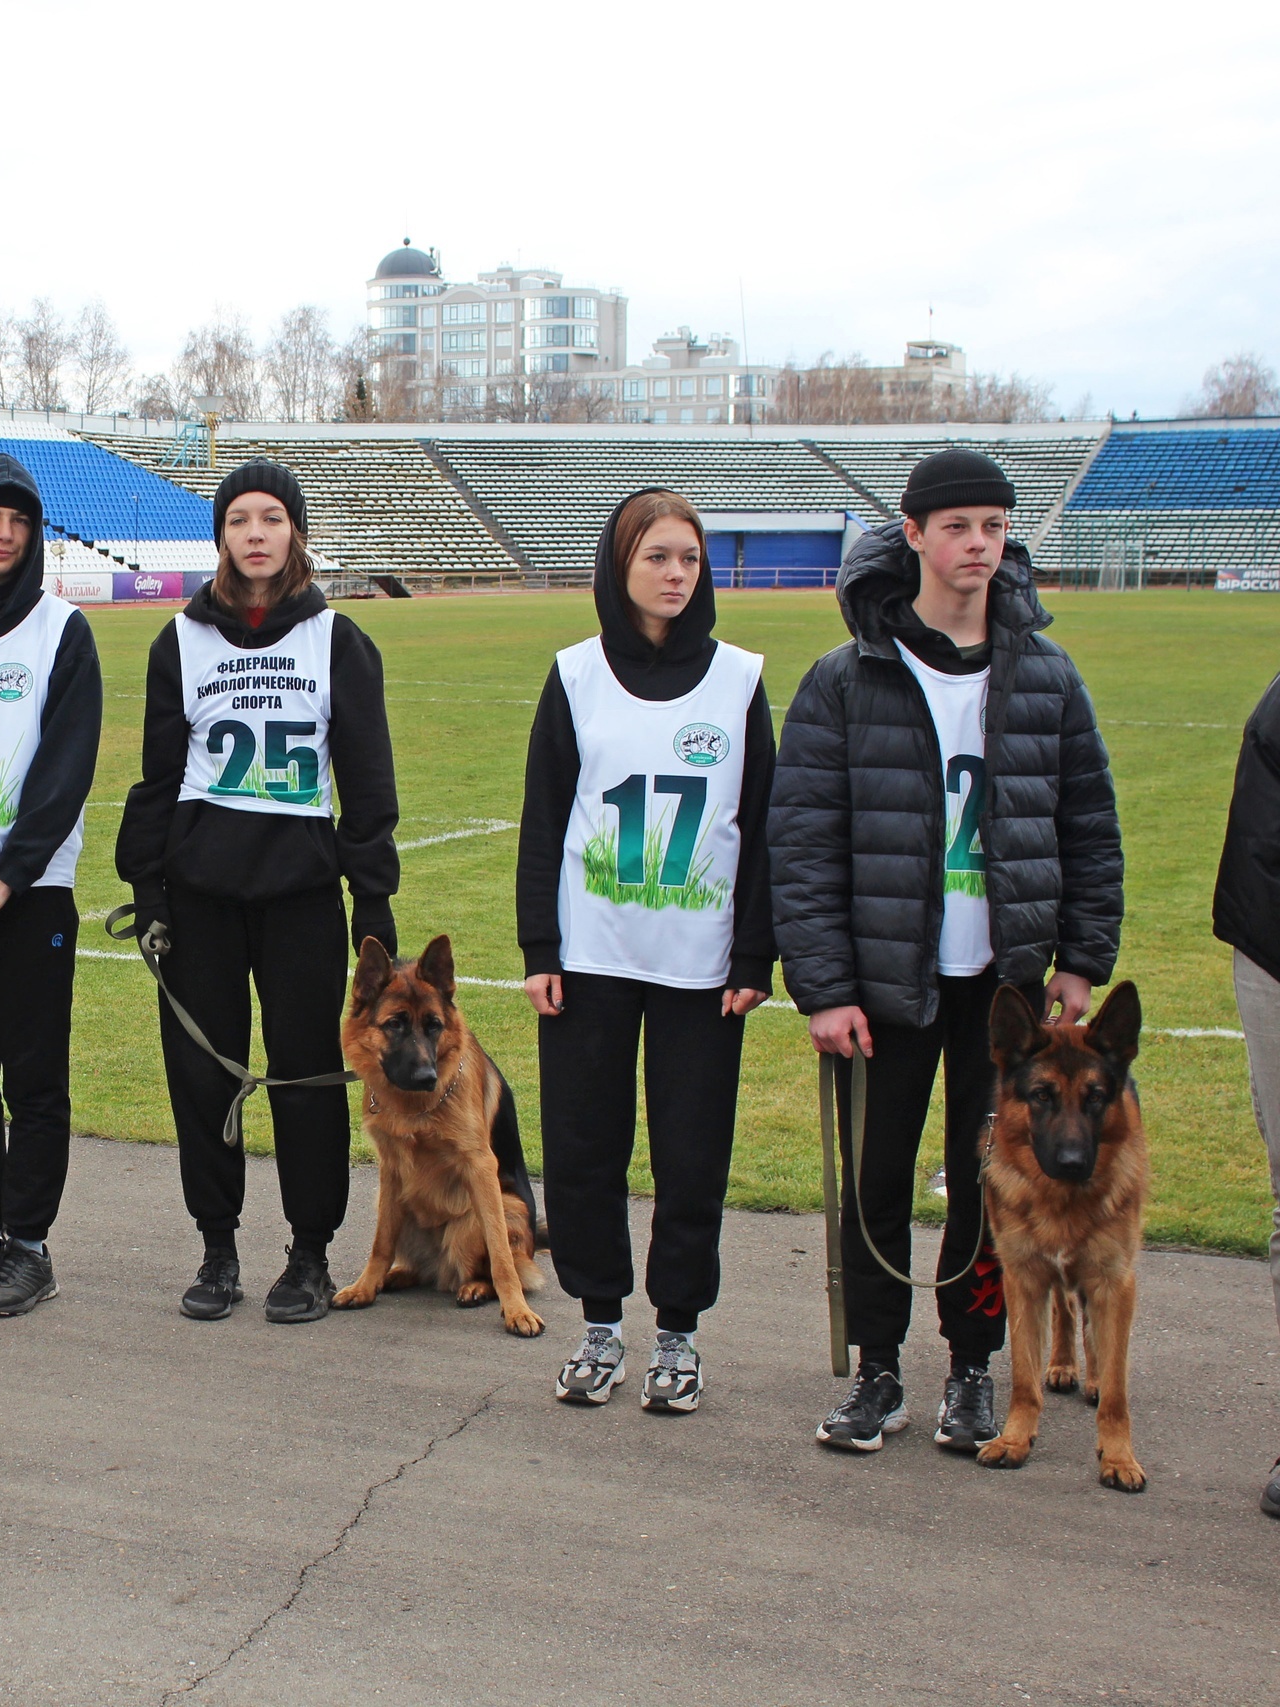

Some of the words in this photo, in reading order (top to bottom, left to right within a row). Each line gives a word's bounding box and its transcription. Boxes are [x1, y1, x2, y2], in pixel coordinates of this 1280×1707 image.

[134, 575, 163, 596] Gallery
[217, 656, 295, 675] ФЕДЕРАЦИЯ
[197, 676, 317, 700] КИНОЛОГИЧЕСКОГО
[231, 695, 283, 710] СПОРТА
[206, 719, 320, 805] 25
[602, 774, 708, 887] 17
